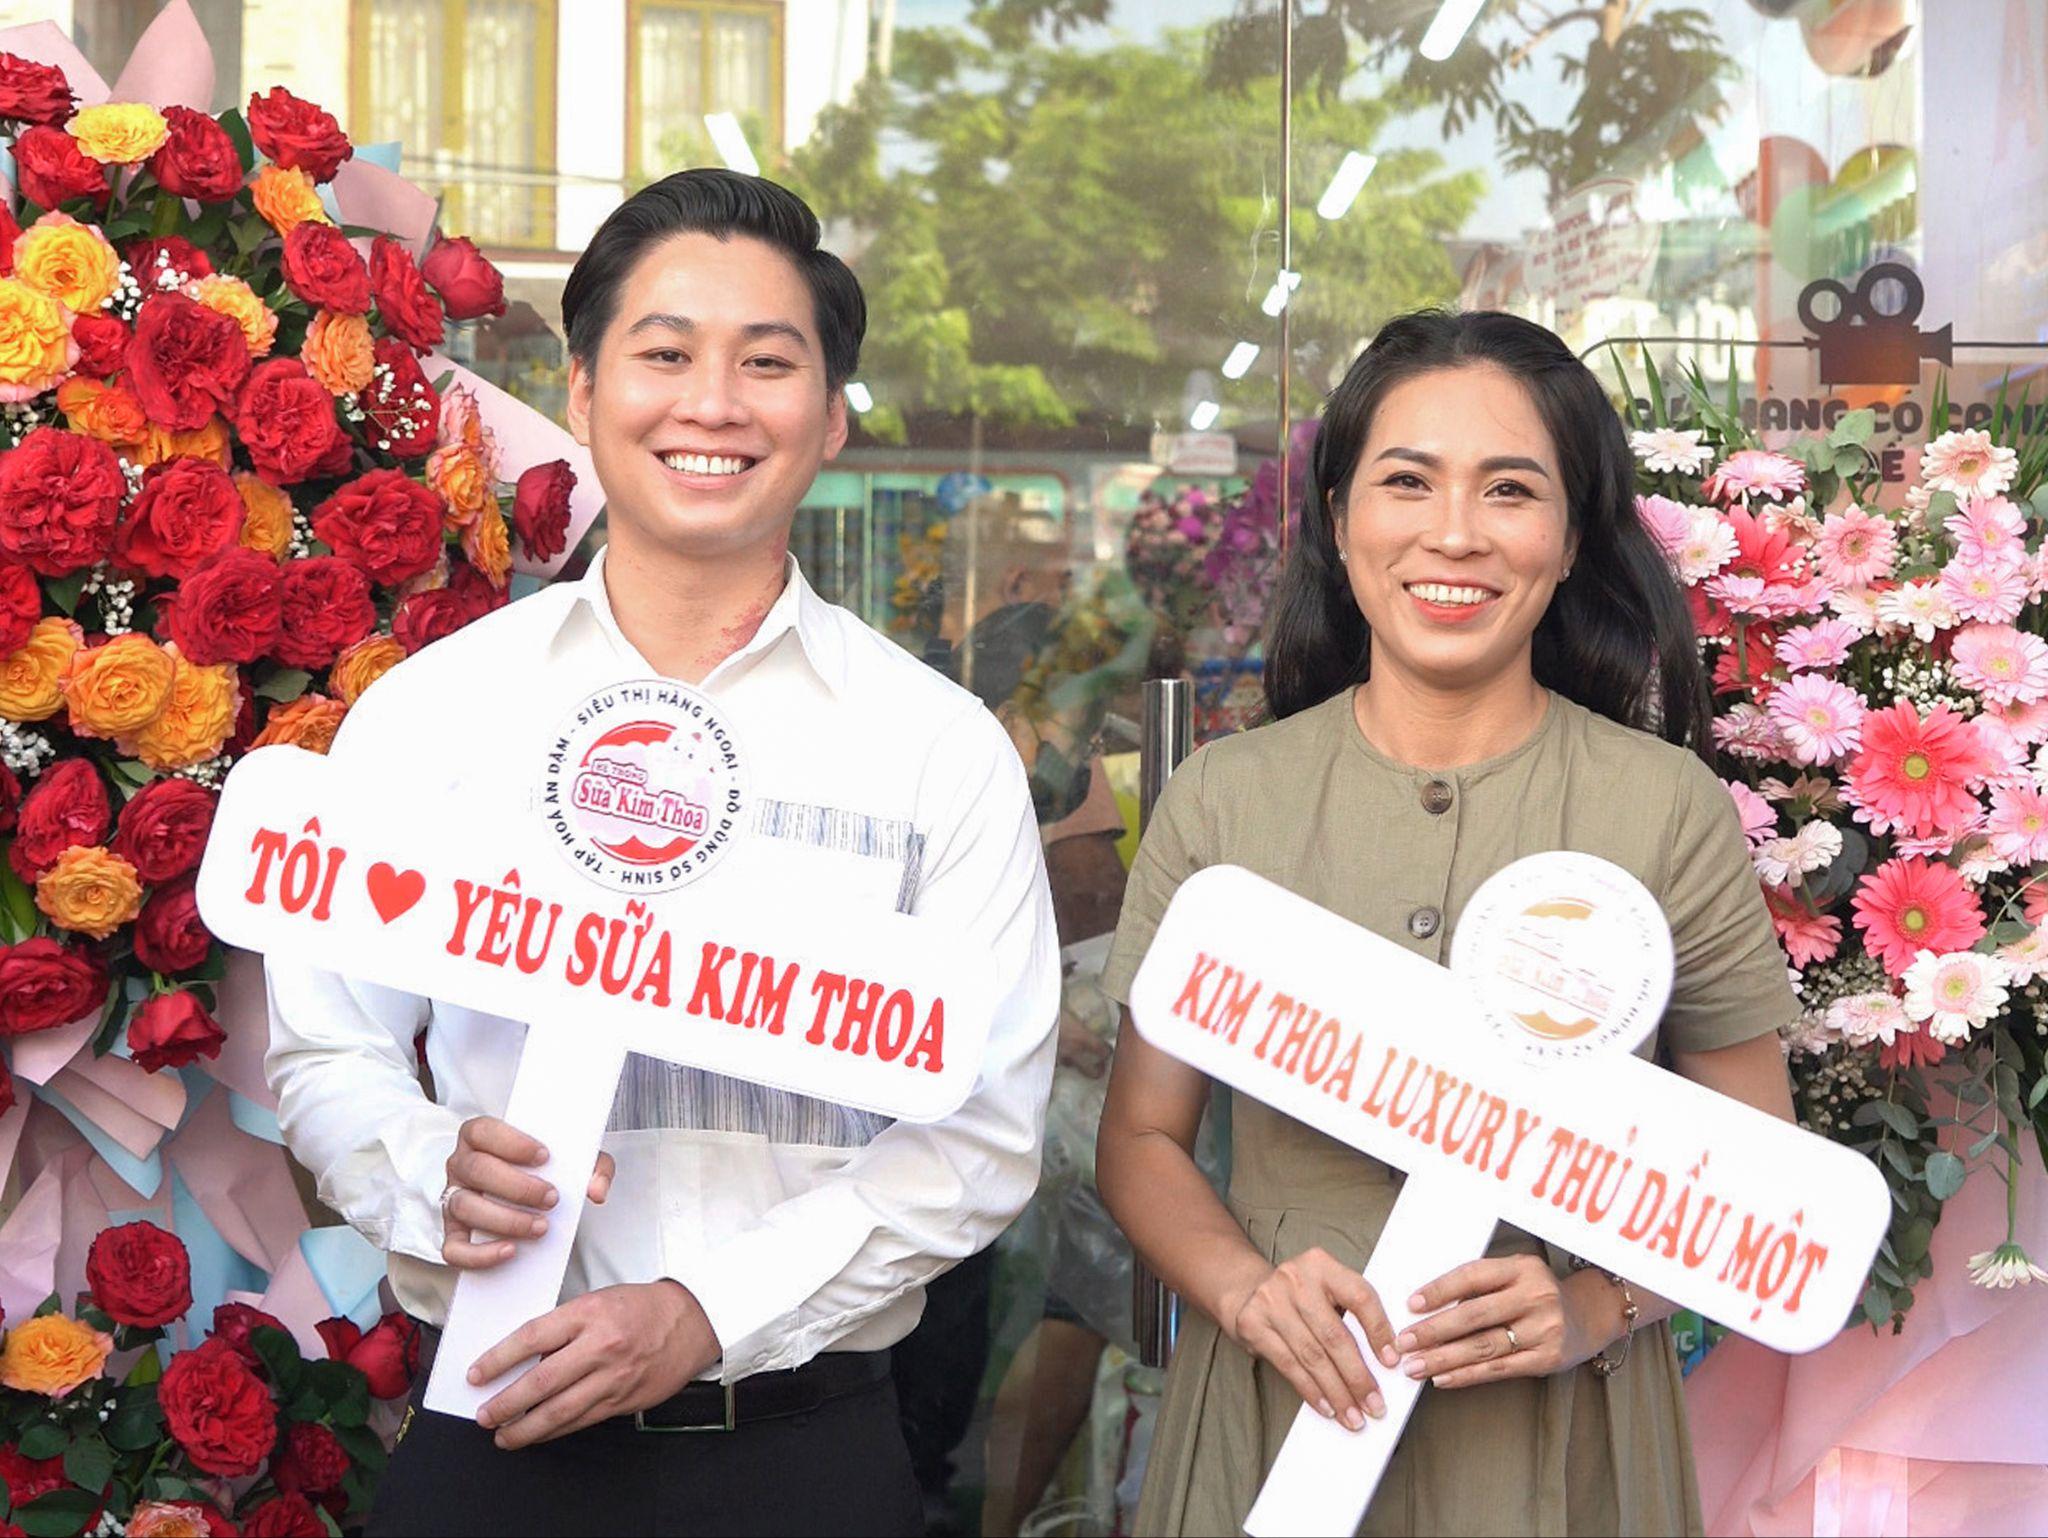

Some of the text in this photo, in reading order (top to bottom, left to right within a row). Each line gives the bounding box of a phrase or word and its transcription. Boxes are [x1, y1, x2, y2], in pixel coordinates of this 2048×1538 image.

[577, 688, 739, 770] SIÊU THỊ HÀNG NGOẠI
[616, 786, 655, 819] Kim
[661, 796, 703, 830] Thoa
[574, 849, 602, 873] TẠP
[695, 818, 733, 863] DÙNG
[621, 870, 664, 885] SINH
[245, 816, 944, 1073] TÔI YÊU SỮA KIM THOA
[1171, 952, 1828, 1321] KIM THOA LUXURY THỦ DẦU MỘT
